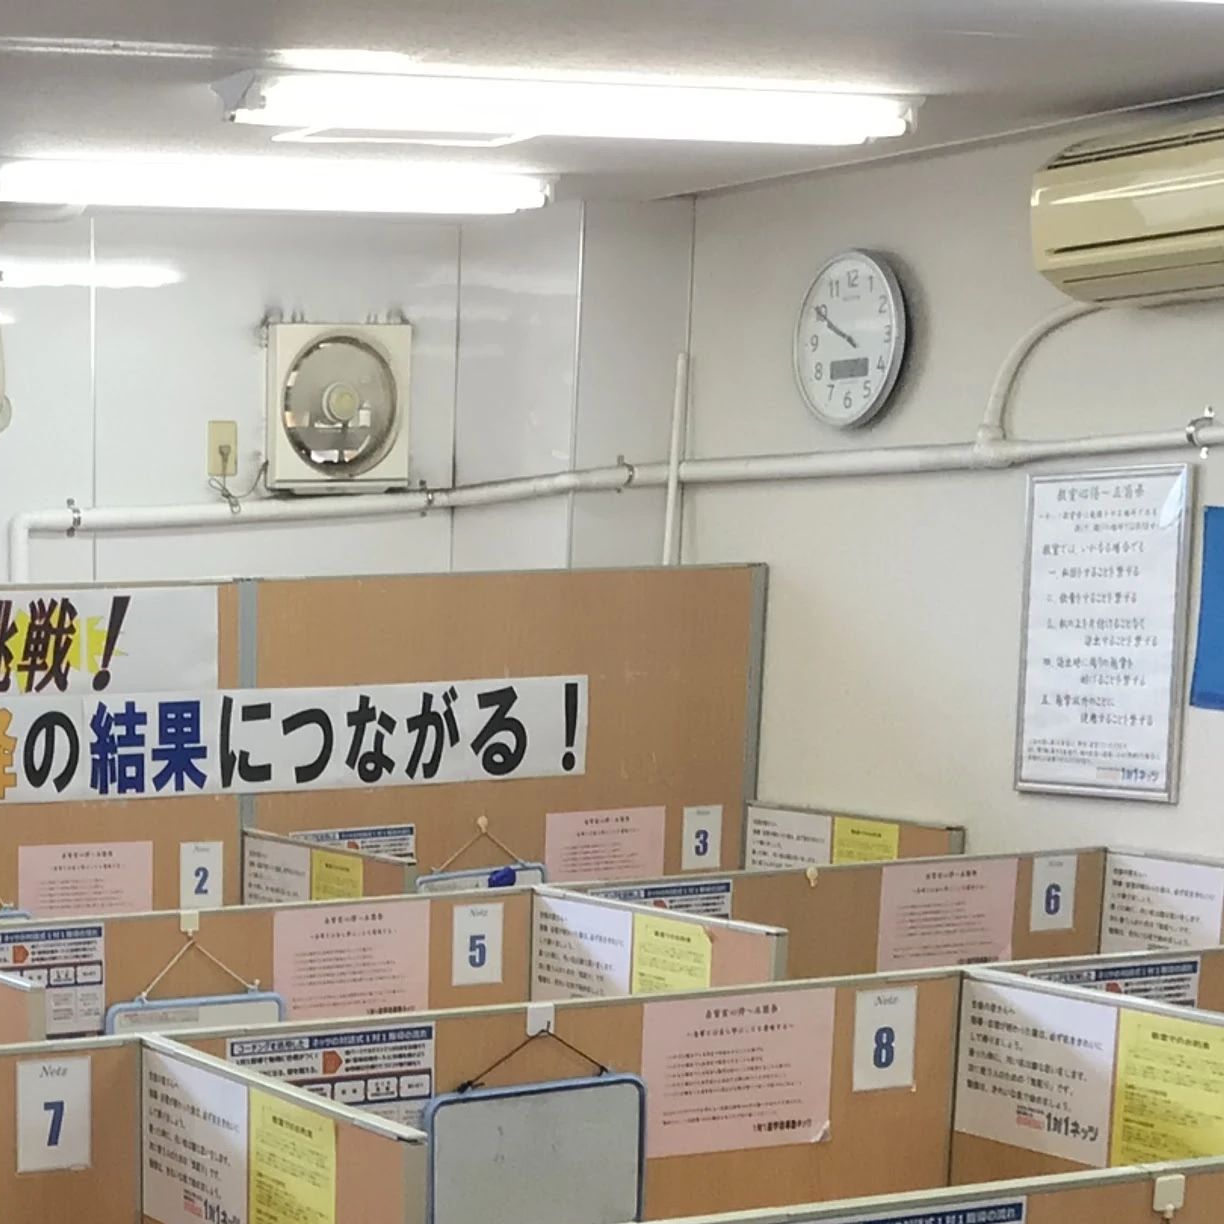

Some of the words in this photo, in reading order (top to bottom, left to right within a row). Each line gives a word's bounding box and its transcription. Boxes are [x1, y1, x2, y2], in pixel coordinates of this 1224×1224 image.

[845, 268, 859, 288] 12
[810, 335, 818, 351] 9
[814, 362, 823, 380] 8
[826, 384, 835, 401] 7
[844, 391, 852, 408] 6
[862, 381, 871, 399] 5
[695, 829, 709, 856] 3
[194, 867, 208, 894] 2
[1045, 884, 1061, 915] 6
[469, 935, 486, 968] 5
[873, 1026, 895, 1069] 8
[44, 1100, 64, 1147] 7
